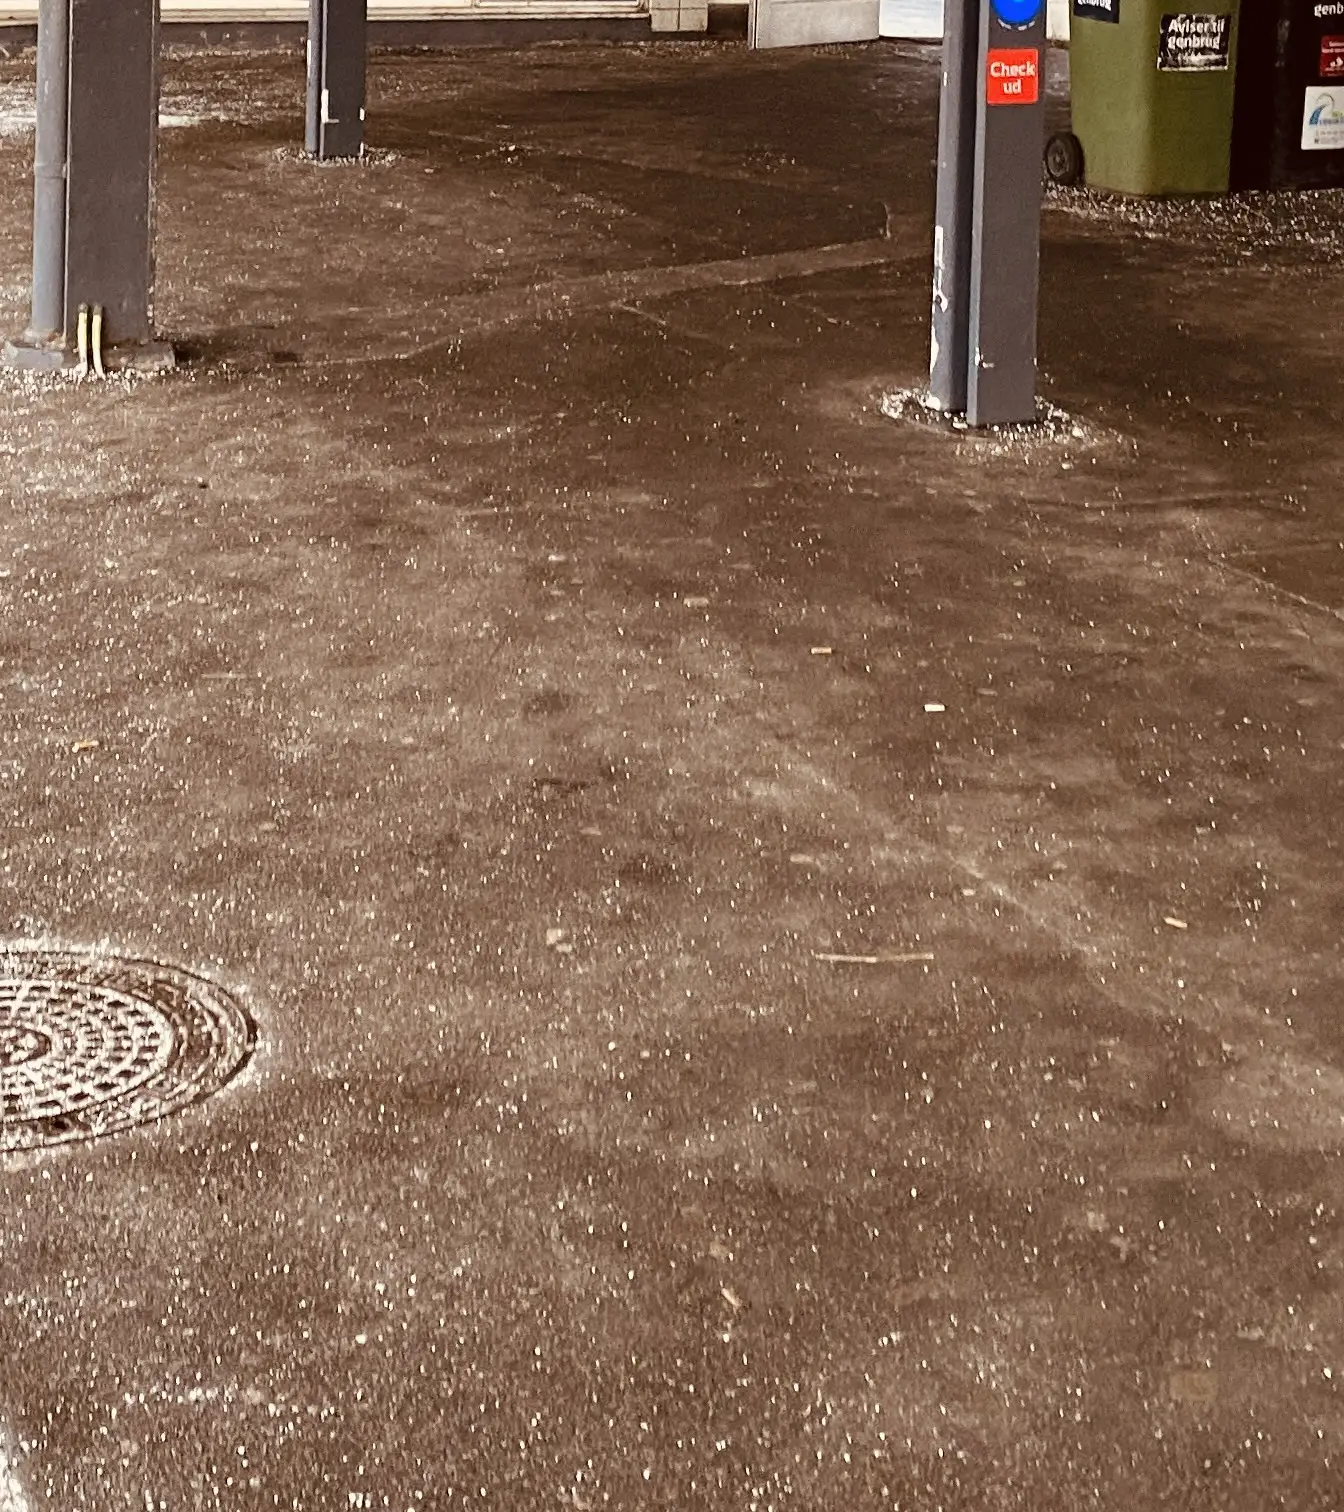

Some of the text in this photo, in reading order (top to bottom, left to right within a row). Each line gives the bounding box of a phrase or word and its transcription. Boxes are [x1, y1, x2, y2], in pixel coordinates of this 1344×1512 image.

[1168, 18, 1226, 35] Aviser til
[989, 61, 1036, 78] Check
[1002, 79, 1023, 95] ud
